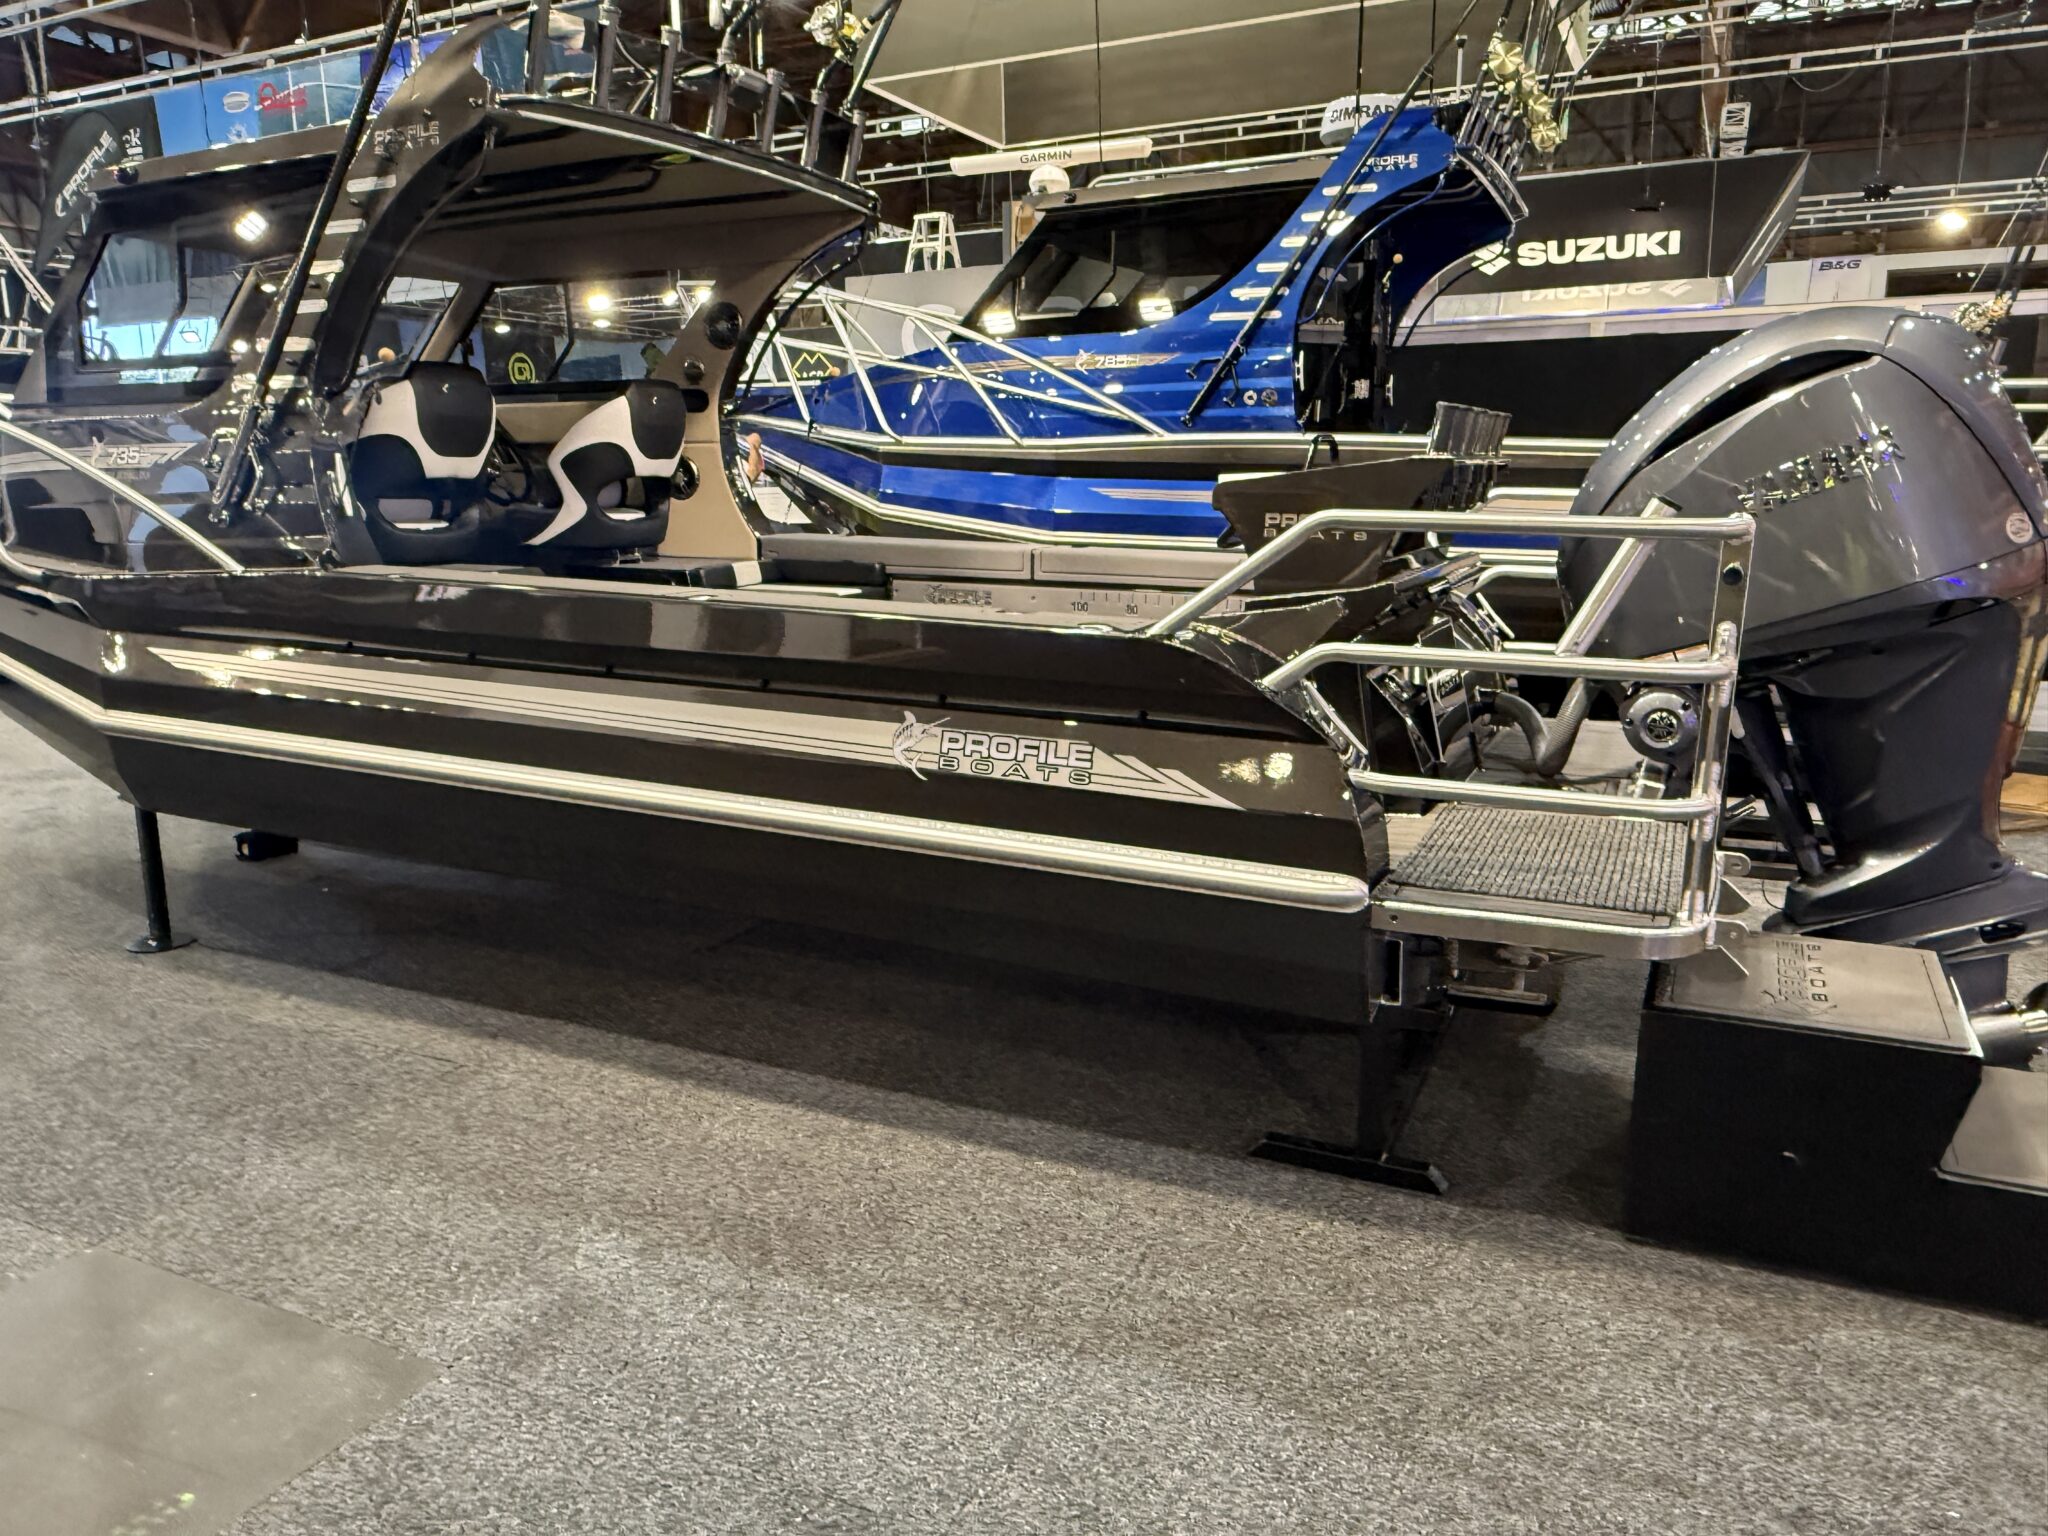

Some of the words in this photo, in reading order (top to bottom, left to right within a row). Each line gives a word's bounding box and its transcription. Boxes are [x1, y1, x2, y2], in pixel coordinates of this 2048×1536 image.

[1329, 105, 1396, 123] SIMRAD
[62, 130, 113, 202] PROFILE
[1020, 150, 1073, 164] GARMIN
[1517, 230, 1681, 267] SUZUKI
[1819, 259, 1863, 271] B&G
[1263, 528, 1368, 541] BATS
[1072, 601, 1089, 613] 100
[940, 729, 1094, 769] PROFILE
[938, 754, 1092, 786] BOATS
[1806, 944, 1829, 1002] BOATS
